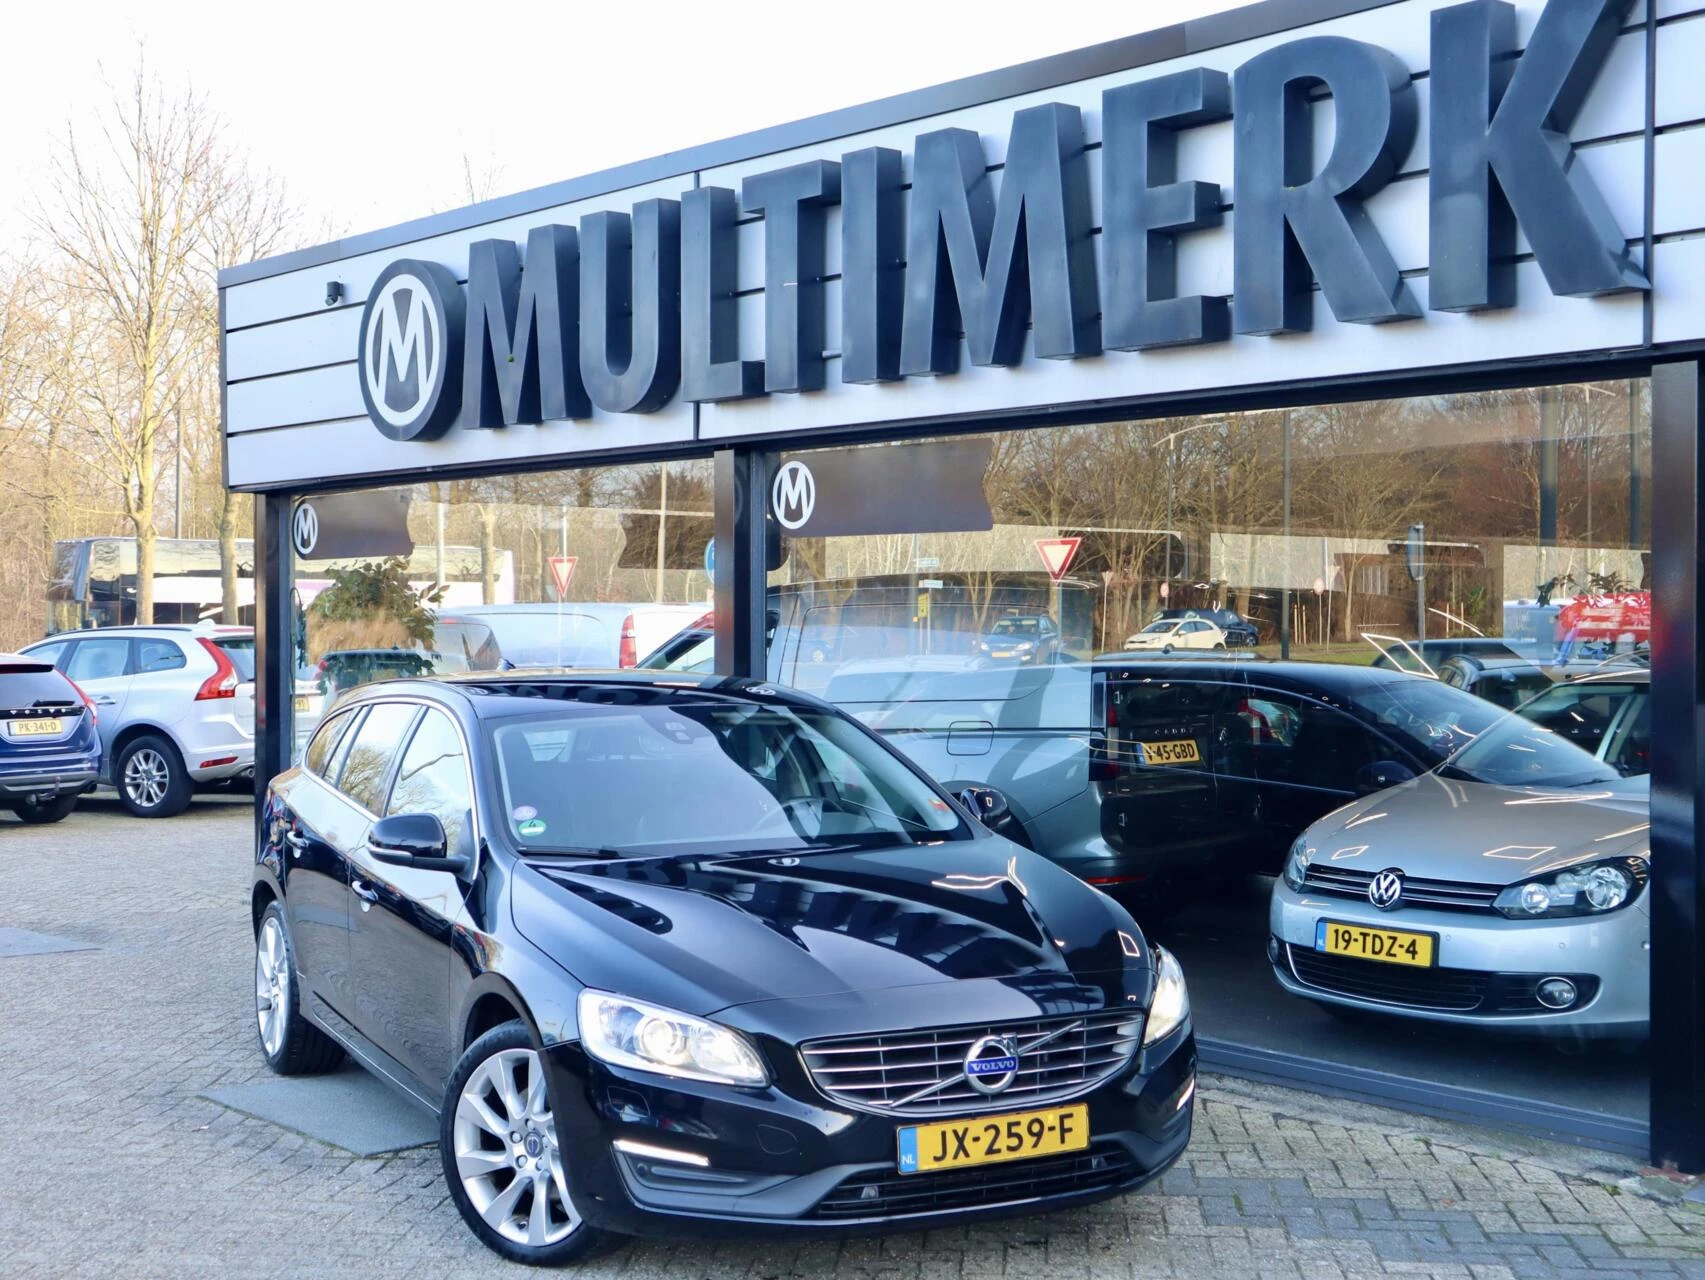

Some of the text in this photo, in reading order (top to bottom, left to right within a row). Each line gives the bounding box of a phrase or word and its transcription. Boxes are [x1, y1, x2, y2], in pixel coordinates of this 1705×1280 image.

[462, 0, 1651, 429] MULTIMERK
[1333, 928, 1418, 961] 19-TDZ-4
[970, 1059, 1015, 1072] VOLVO
[902, 1112, 1074, 1165] NL JX-259-F
